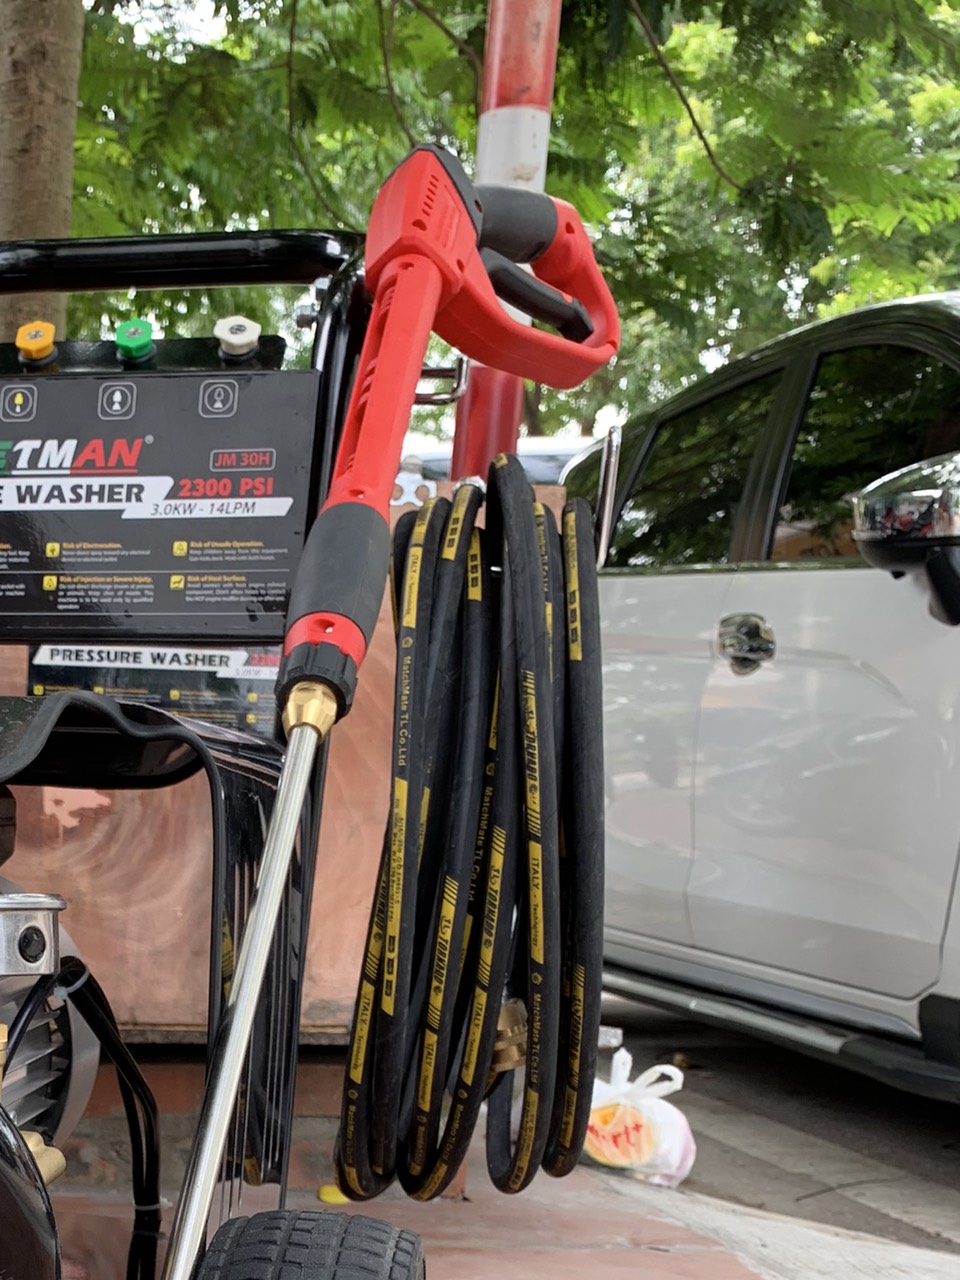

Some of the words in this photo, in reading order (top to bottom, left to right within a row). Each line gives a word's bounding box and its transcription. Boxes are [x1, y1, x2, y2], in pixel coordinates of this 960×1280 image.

[215, 452, 236, 468] JM
[240, 451, 270, 467] 30H
[16, 483, 145, 505] WASHER
[178, 477, 232, 498] 2300
[240, 476, 275, 496] PSI
[151, 502, 197, 516] 3.0KW
[209, 501, 257, 515] 14LPM
[49, 648, 142, 664] PRESSURE
[151, 651, 230, 668] WASHER
[400, 656, 411, 711] MatchMate
[399, 712, 409, 727] TL
[525, 731, 538, 782] TORNADO
[476, 787, 493, 845] MatchMate
[531, 857, 540, 890] ITALY
[483, 887, 499, 939] TORNADO
[433, 935, 449, 985] TORNADO
[359, 995, 370, 1026] ITALY
[473, 1002, 483, 1029] ITALY
[532, 993, 542, 1042] MatchMate
[424, 1042, 434, 1068] ITALY
